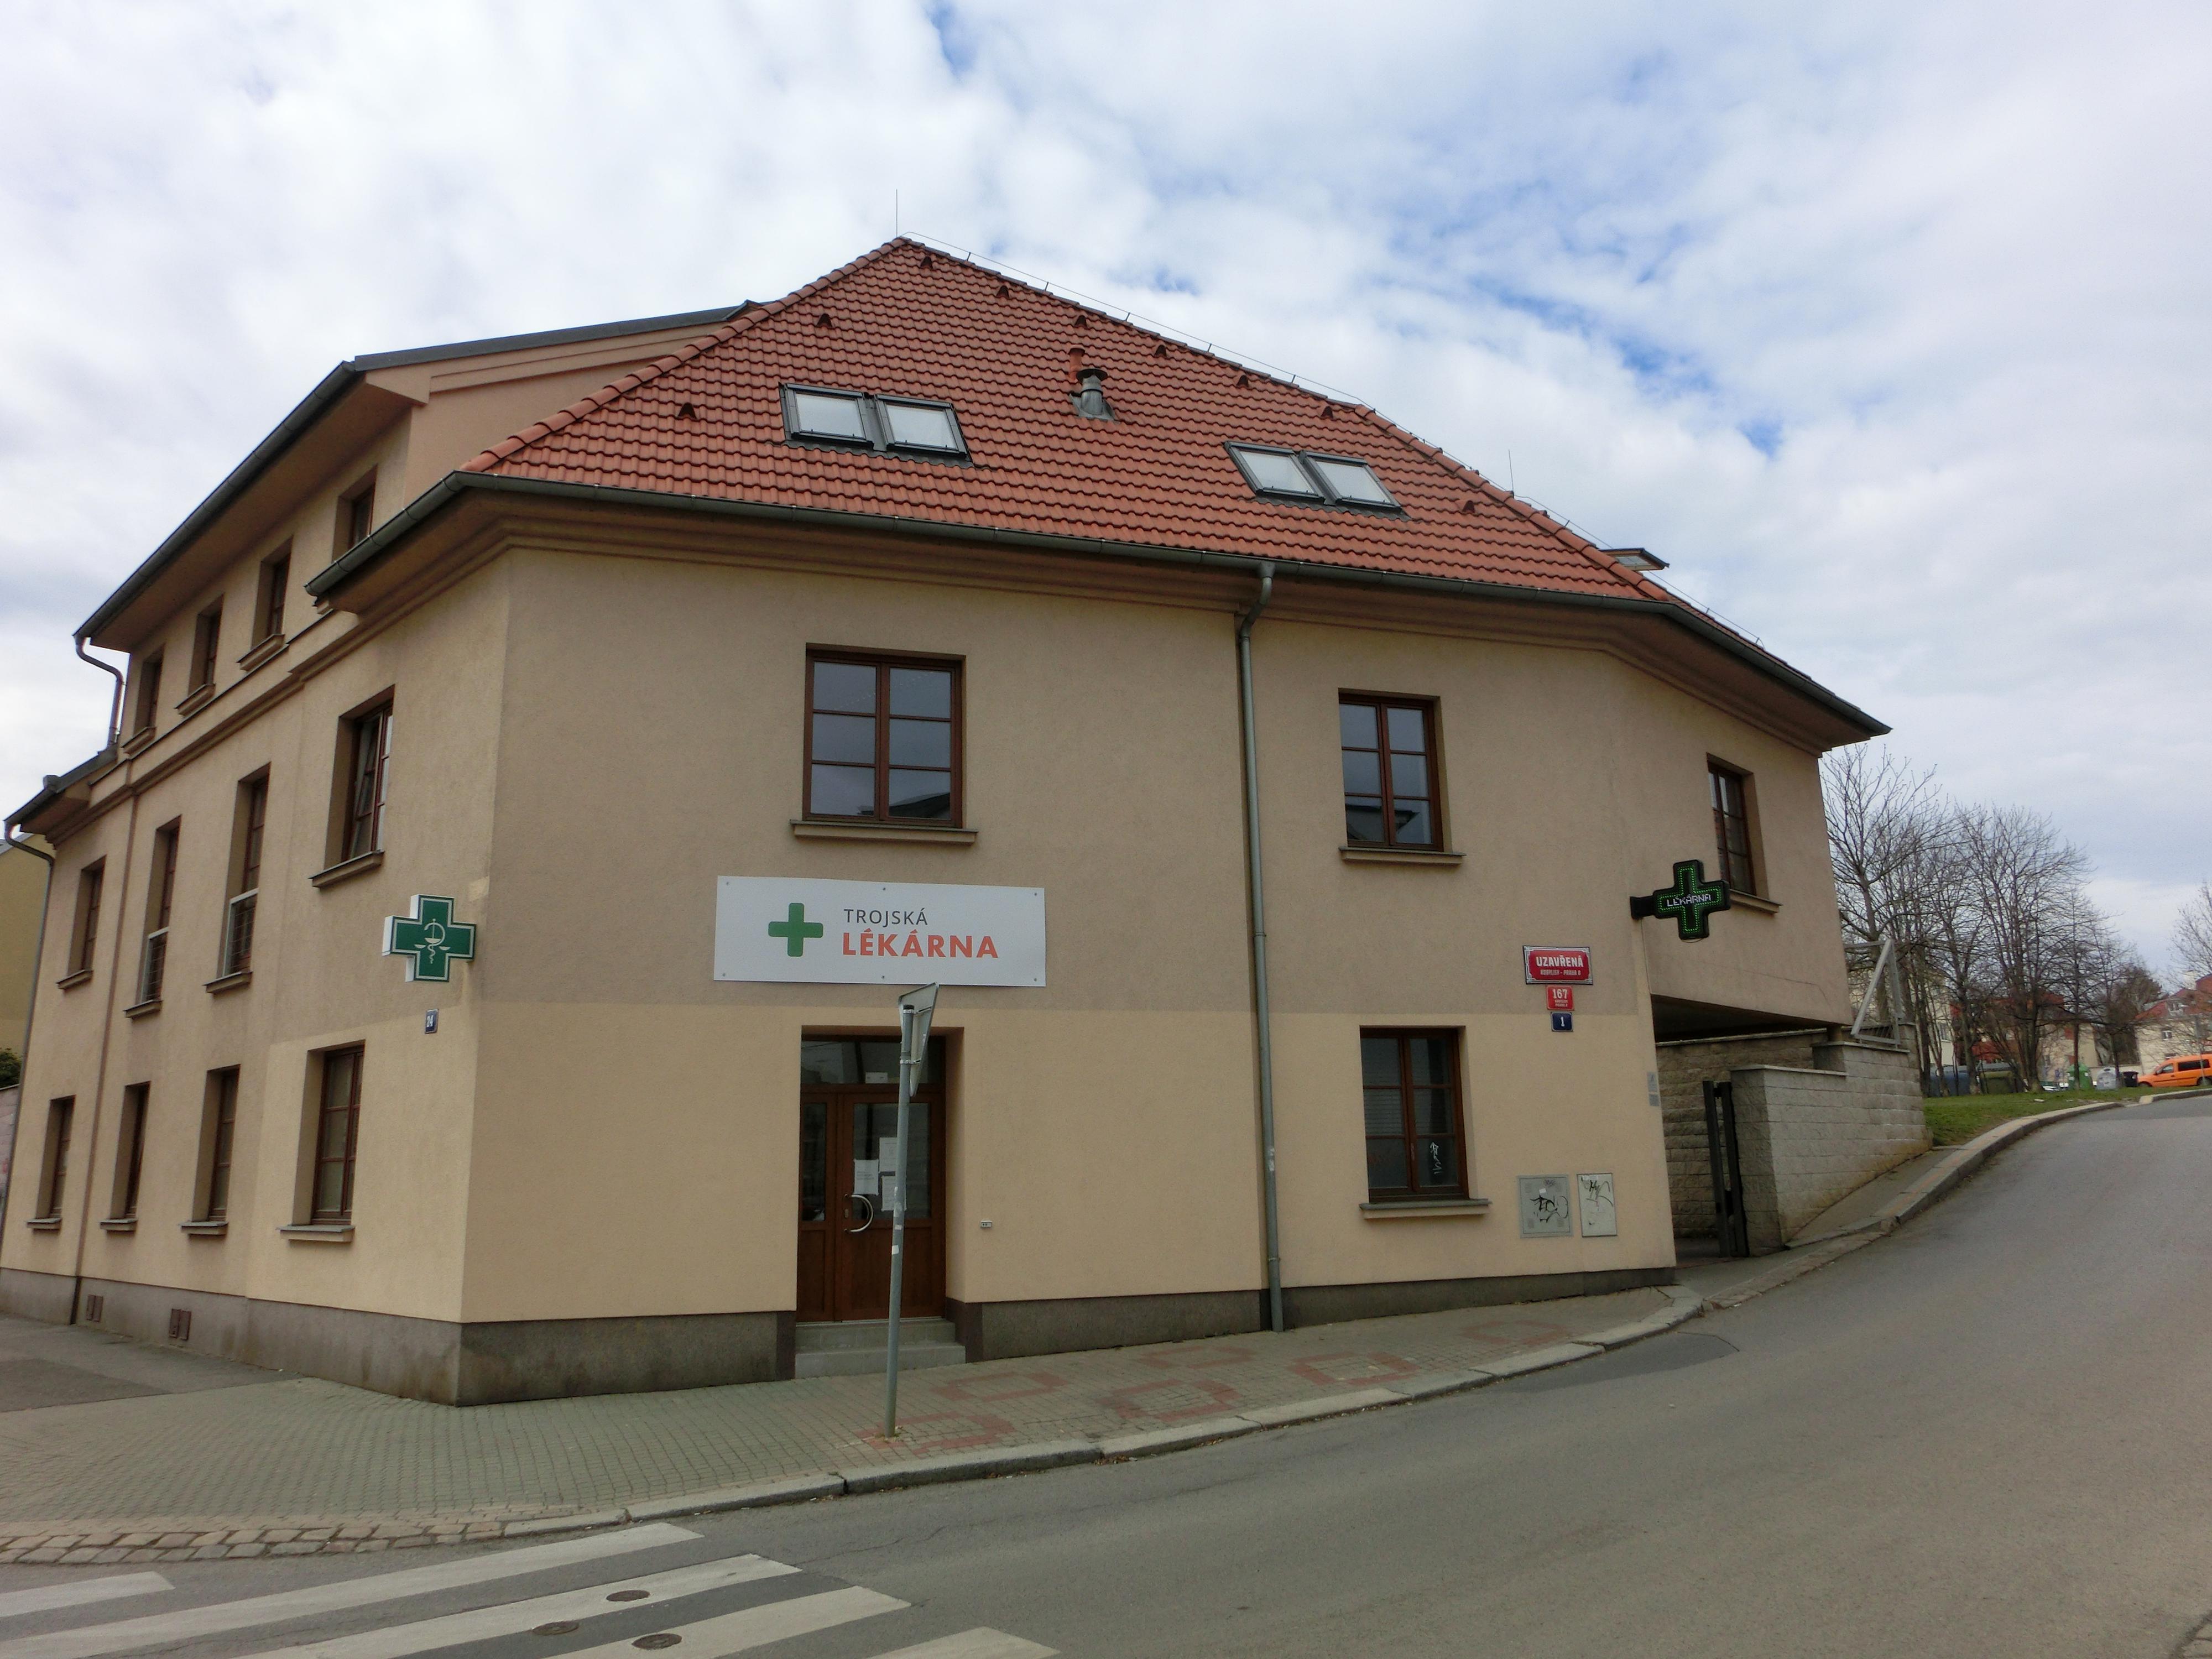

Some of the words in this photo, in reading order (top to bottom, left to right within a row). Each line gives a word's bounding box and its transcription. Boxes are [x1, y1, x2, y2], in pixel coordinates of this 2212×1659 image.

[843, 907, 928, 927] TROJSKÁ
[843, 928, 999, 958] LÉKÁRNA
[1536, 954, 1584, 967] UZAVŘENÁ
[1553, 988, 1568, 999] 167
[426, 1015, 434, 1027] 24
[1561, 1016, 1565, 1027] 1
